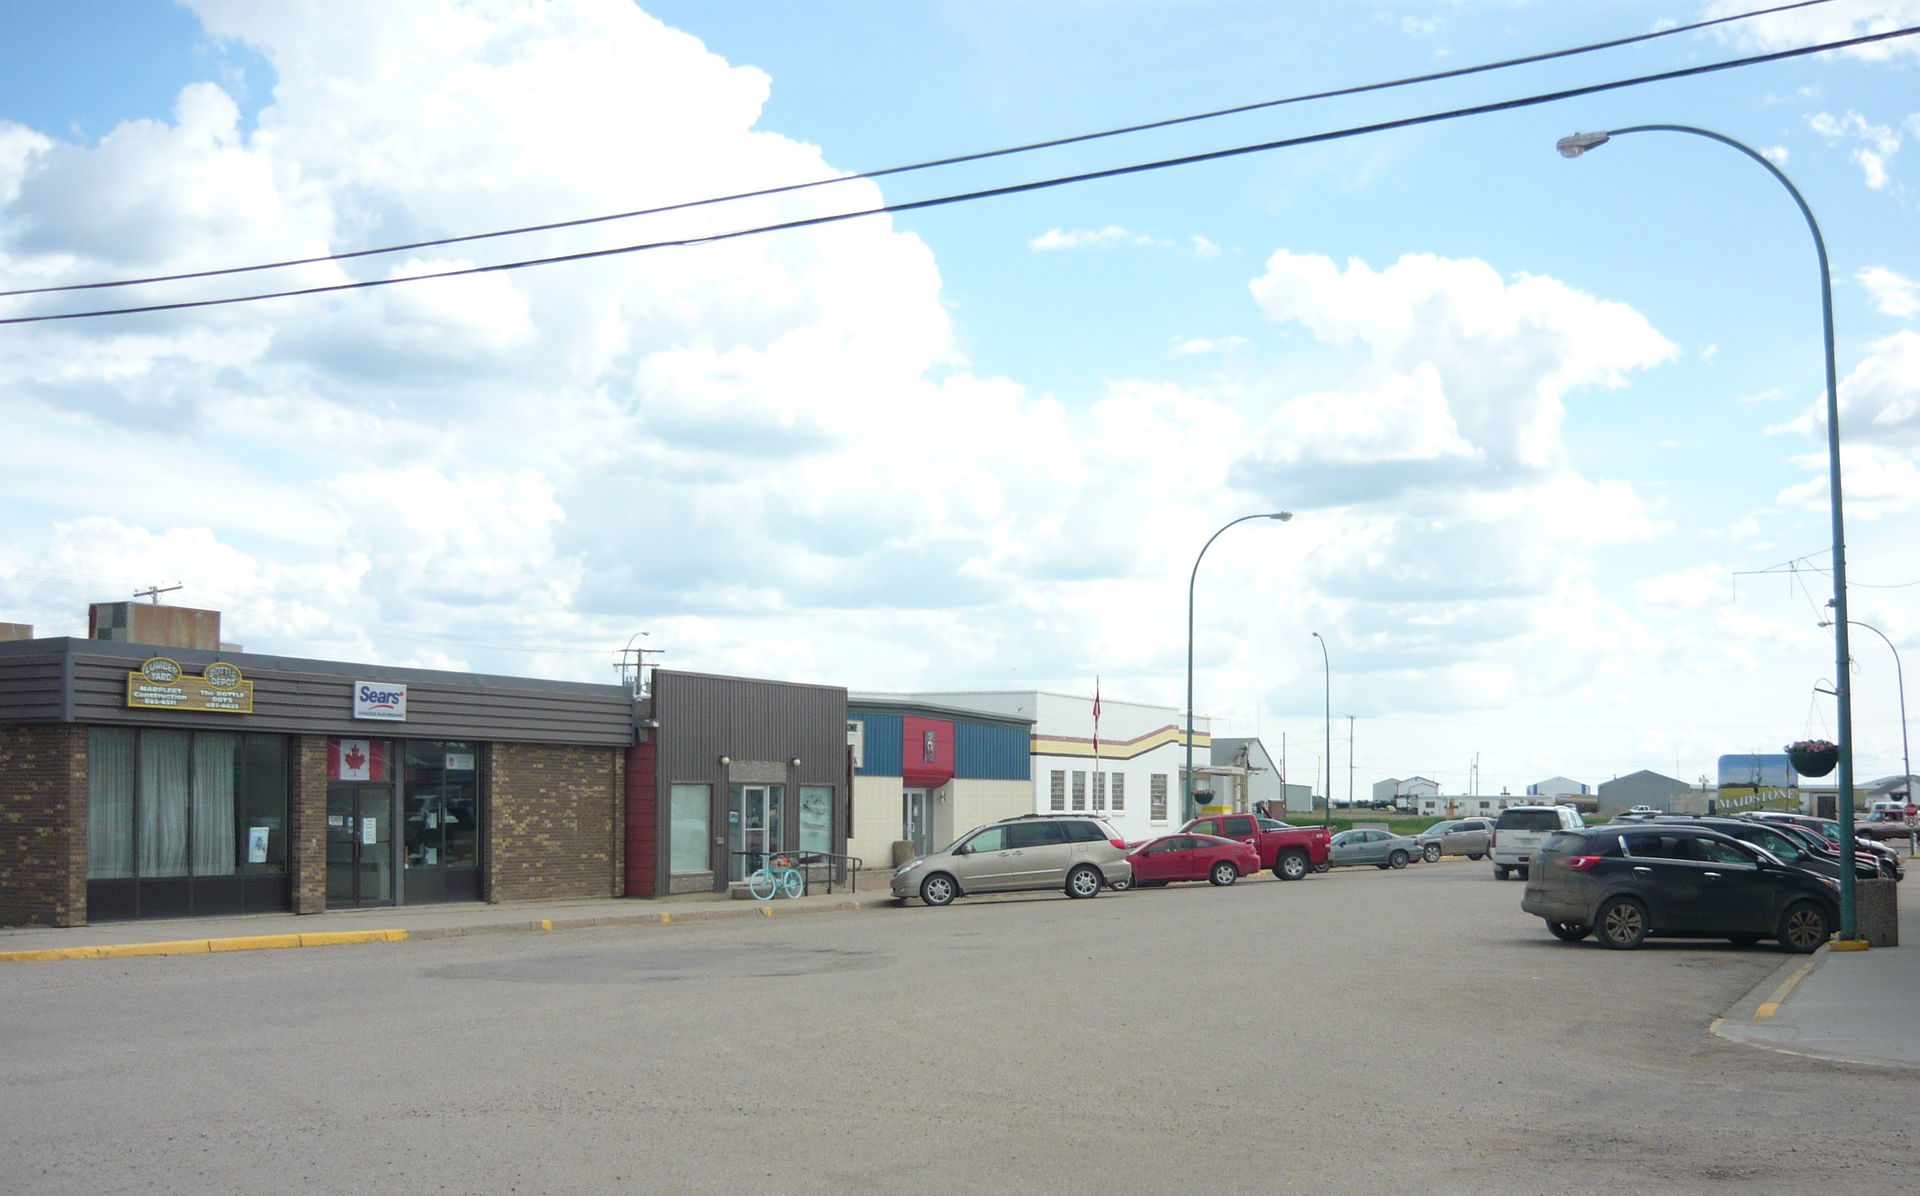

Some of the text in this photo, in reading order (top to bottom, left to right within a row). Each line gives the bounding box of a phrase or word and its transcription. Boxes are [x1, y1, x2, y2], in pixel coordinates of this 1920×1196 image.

[145, 661, 178, 674] LUMBER
[209, 667, 238, 679] BOTTLE
[151, 673, 172, 681] YARD
[211, 677, 236, 686] DEPOT
[360, 685, 400, 704] Sears
[1719, 789, 1794, 808] MAIDSTONE
